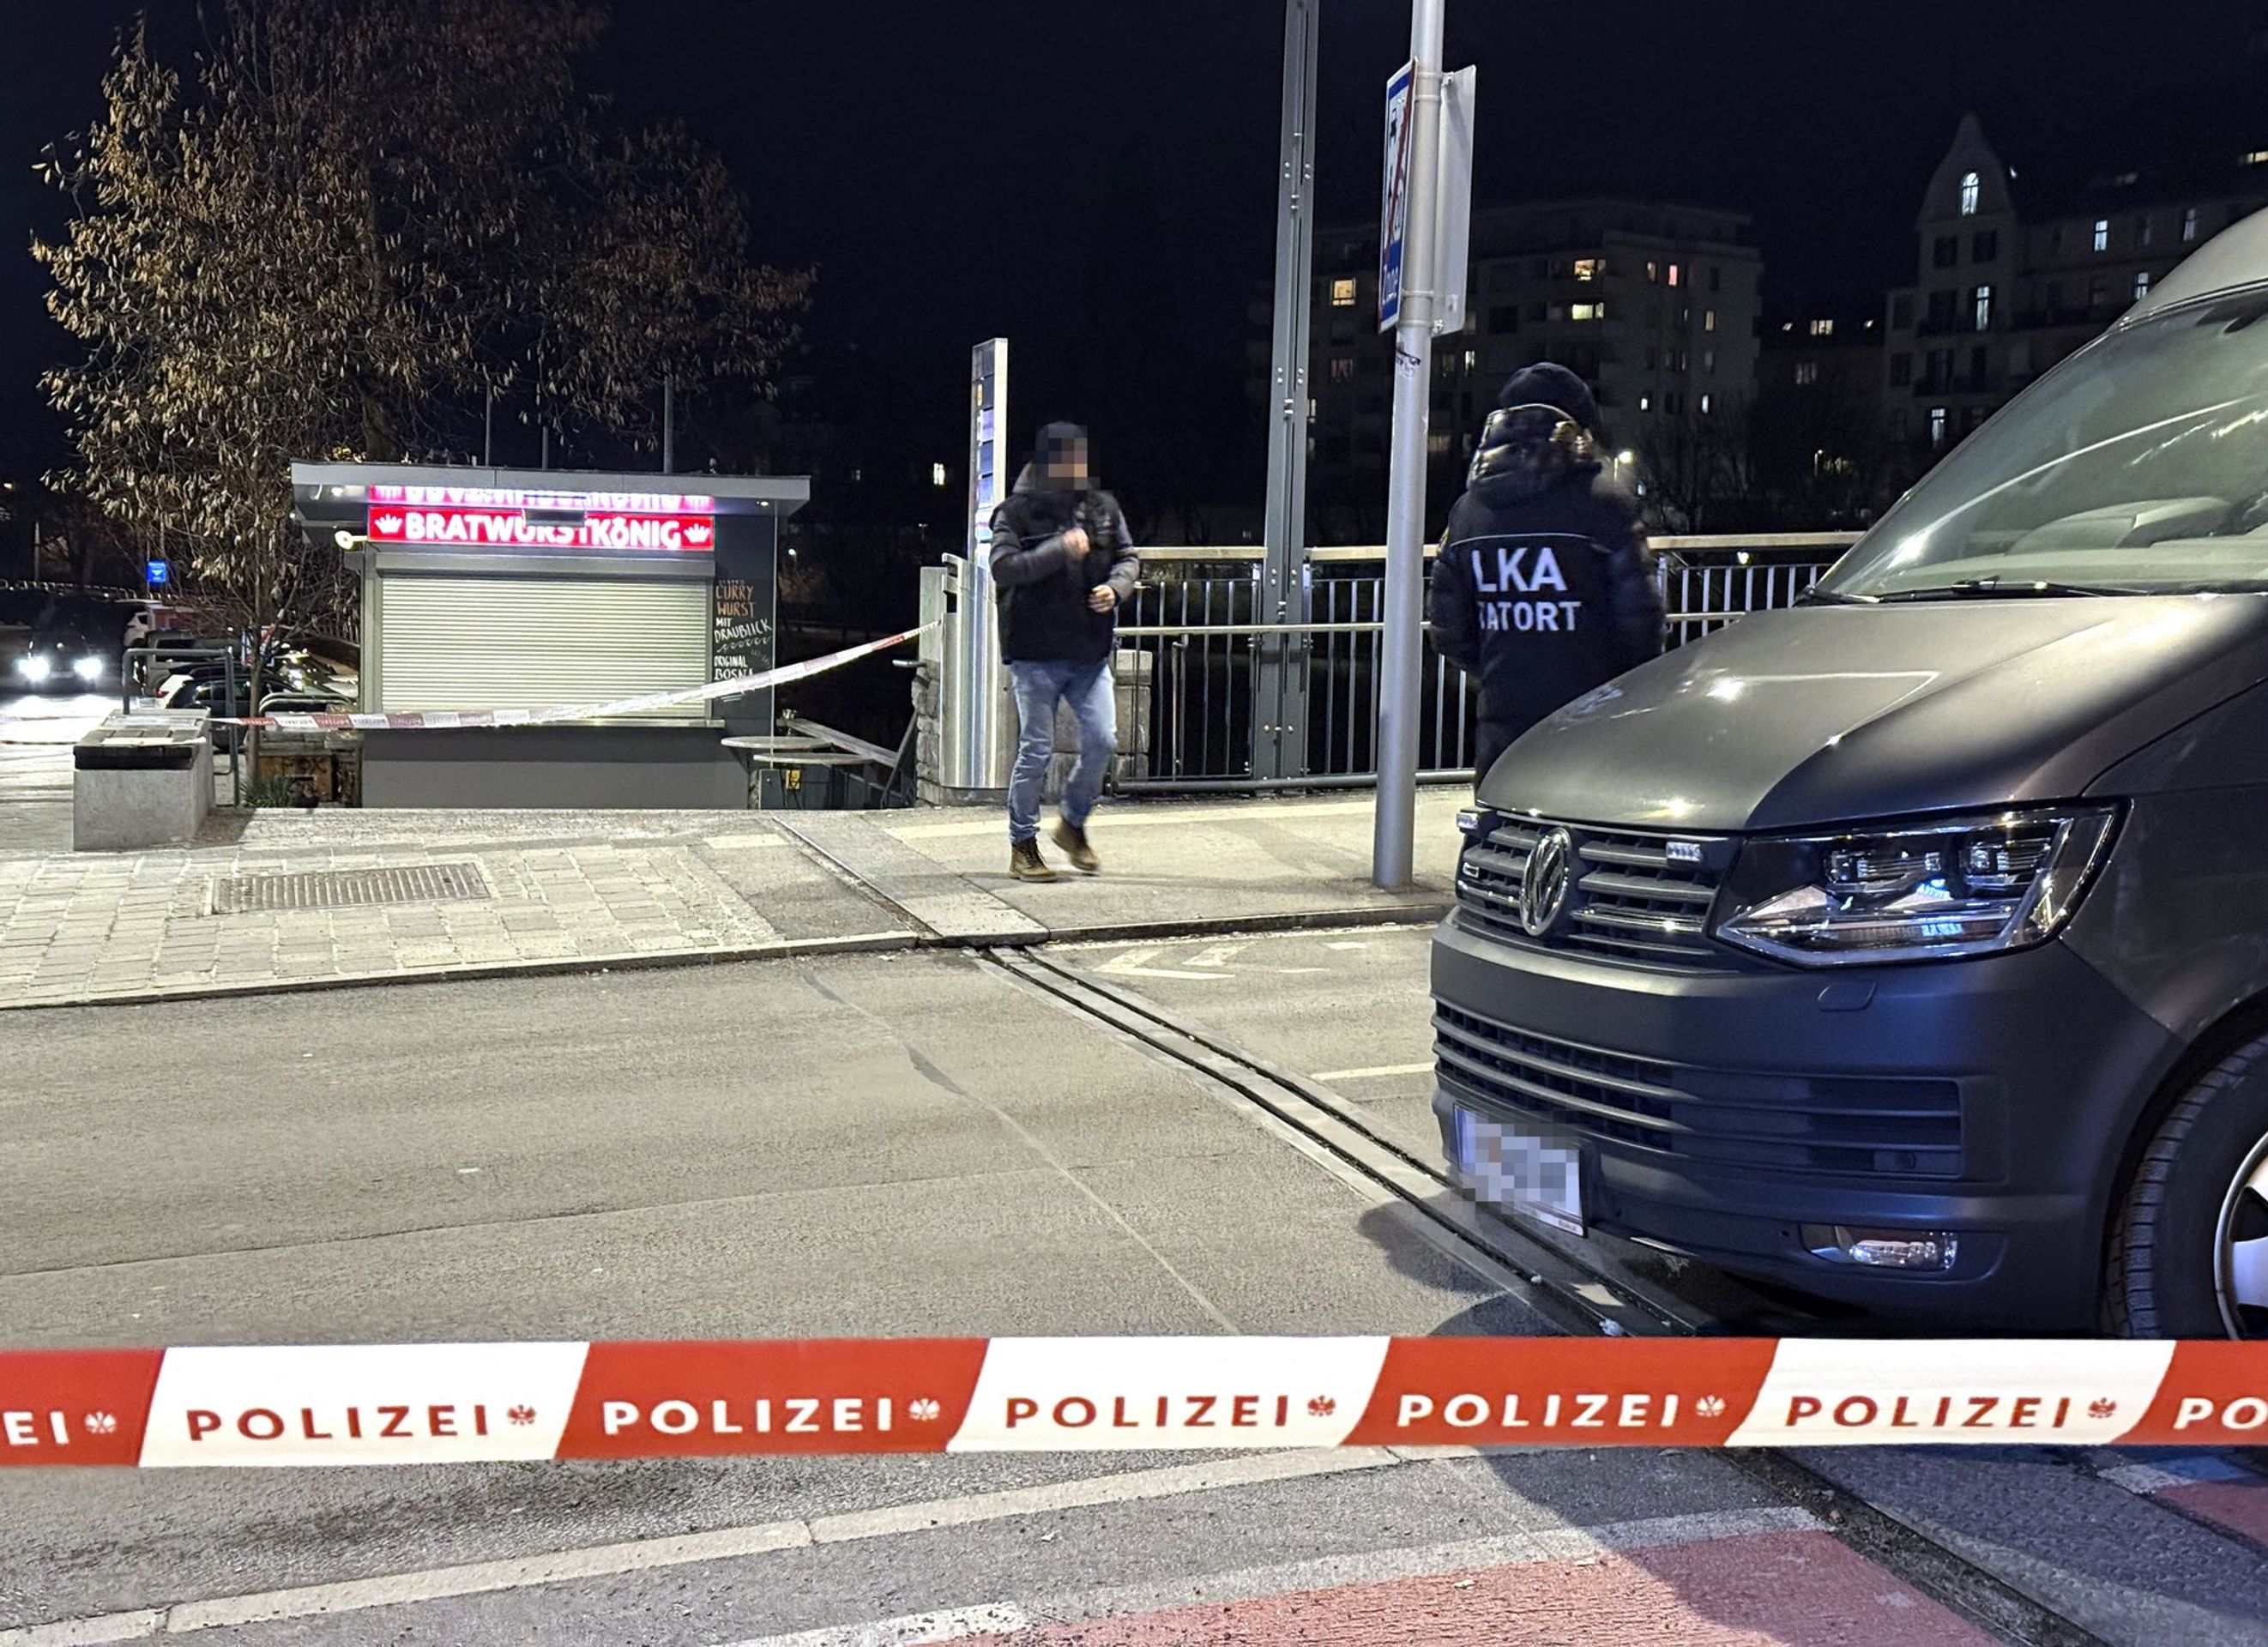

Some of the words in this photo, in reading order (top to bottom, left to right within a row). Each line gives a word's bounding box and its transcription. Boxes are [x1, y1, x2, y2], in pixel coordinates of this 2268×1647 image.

[1471, 547, 1567, 592] LKA
[715, 585, 755, 600] CURRY
[716, 601, 756, 618] WURST
[715, 618, 733, 627] MIT
[186, 1404, 487, 1441] POLIZEI
[603, 1398, 892, 1435] POLIZEI
[1006, 1395, 1288, 1428] POLIZEI
[1397, 1394, 1679, 1427] POLIZEI
[1786, 1396, 2070, 1428] POLIZEI
